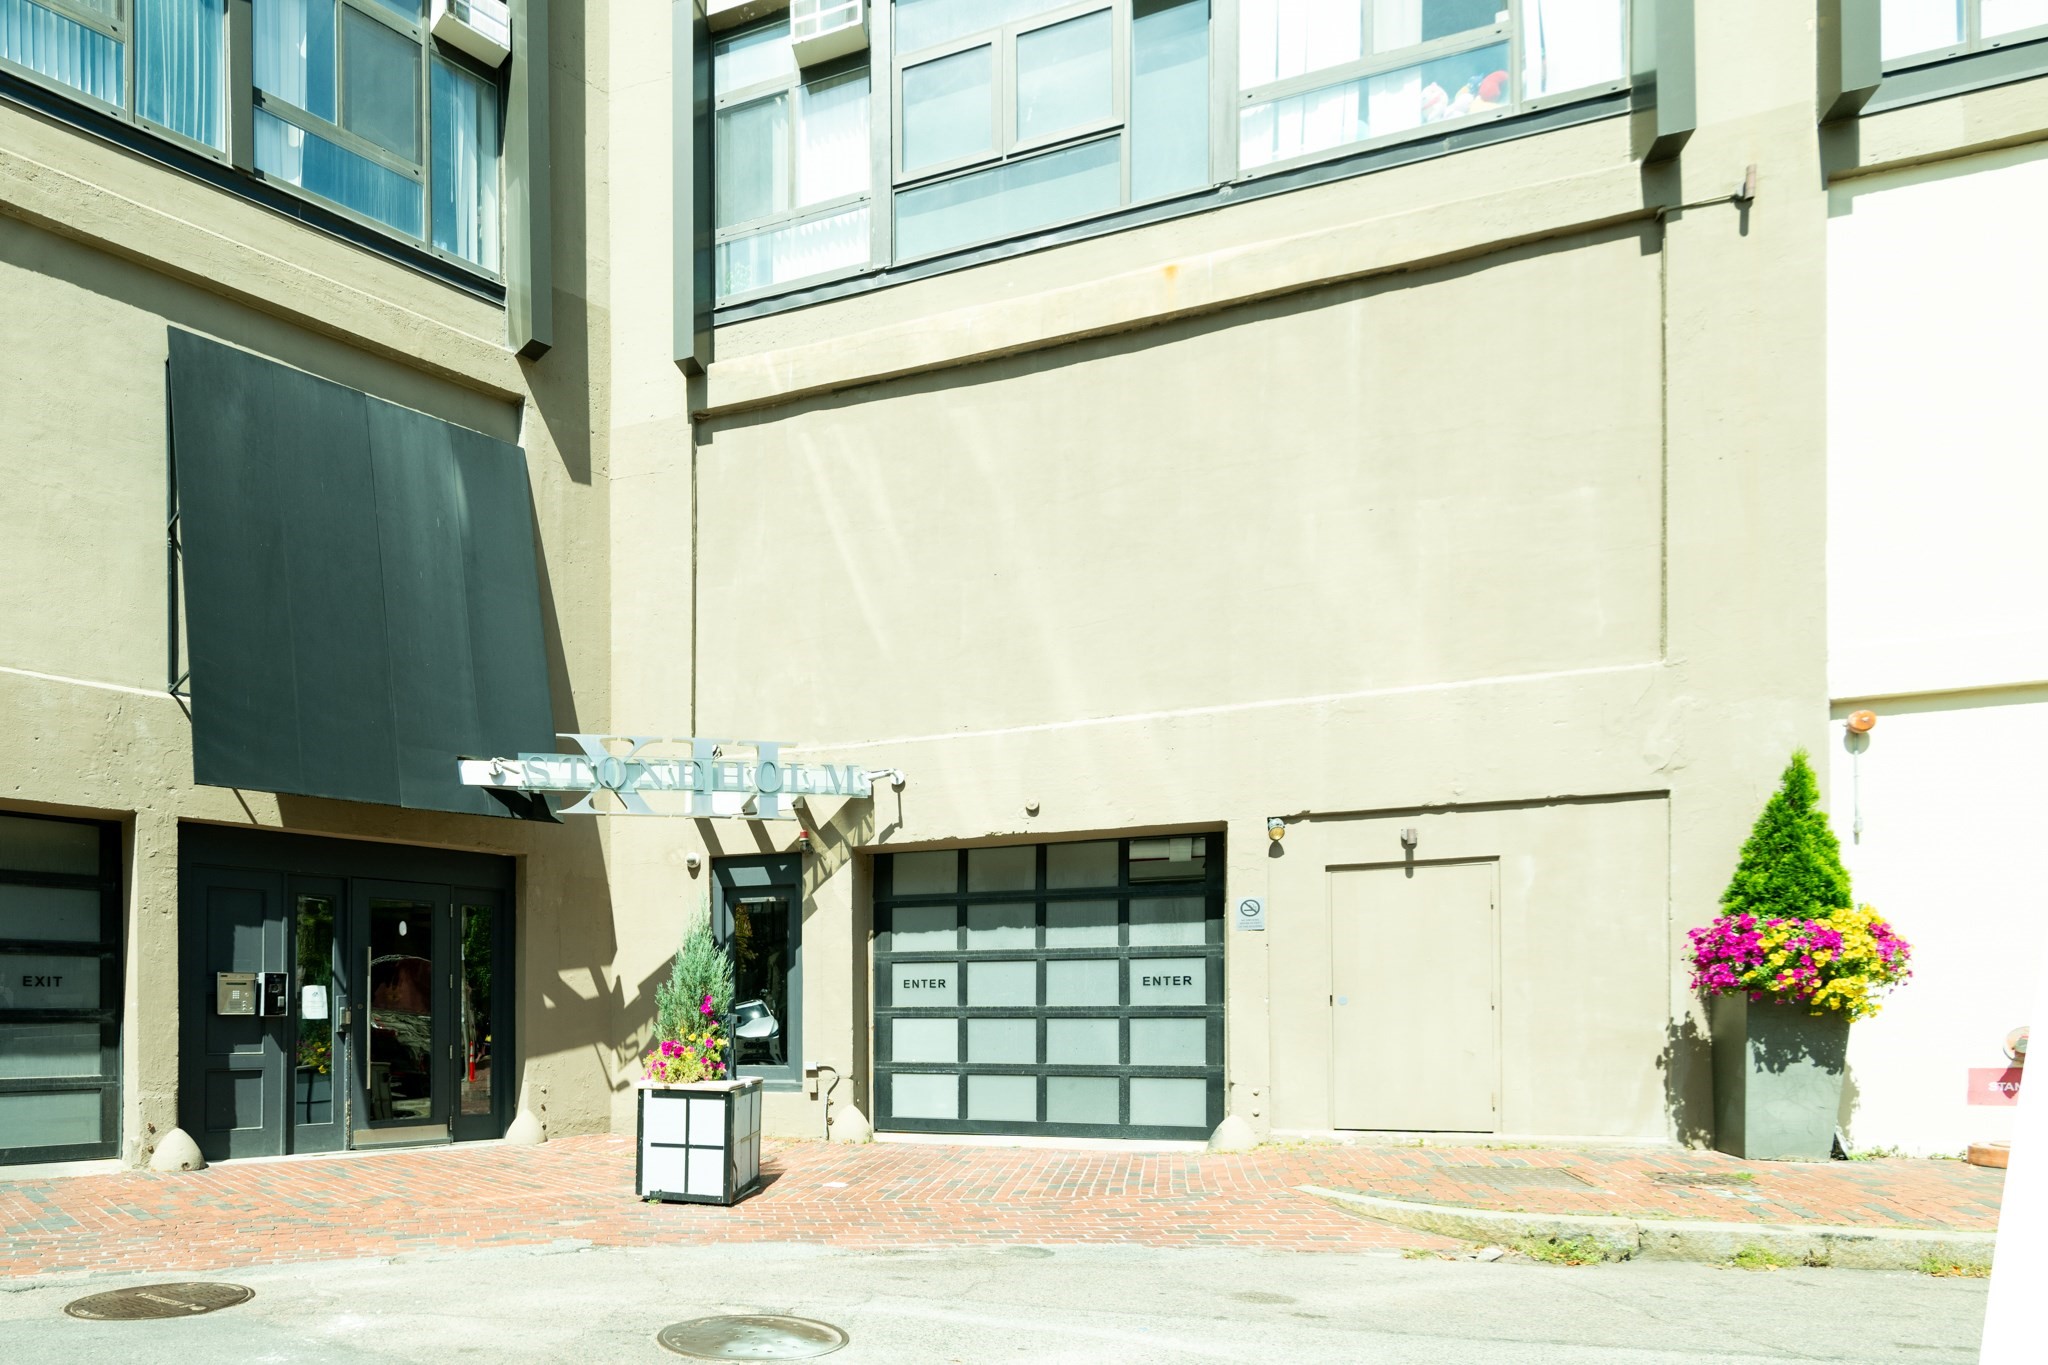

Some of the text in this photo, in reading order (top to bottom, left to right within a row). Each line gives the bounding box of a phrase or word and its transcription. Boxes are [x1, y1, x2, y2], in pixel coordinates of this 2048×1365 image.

[526, 756, 858, 795] STONEHOLM
[22, 975, 63, 987] EXIT
[903, 978, 946, 989] ENTER
[1142, 975, 1192, 986] ENTER
